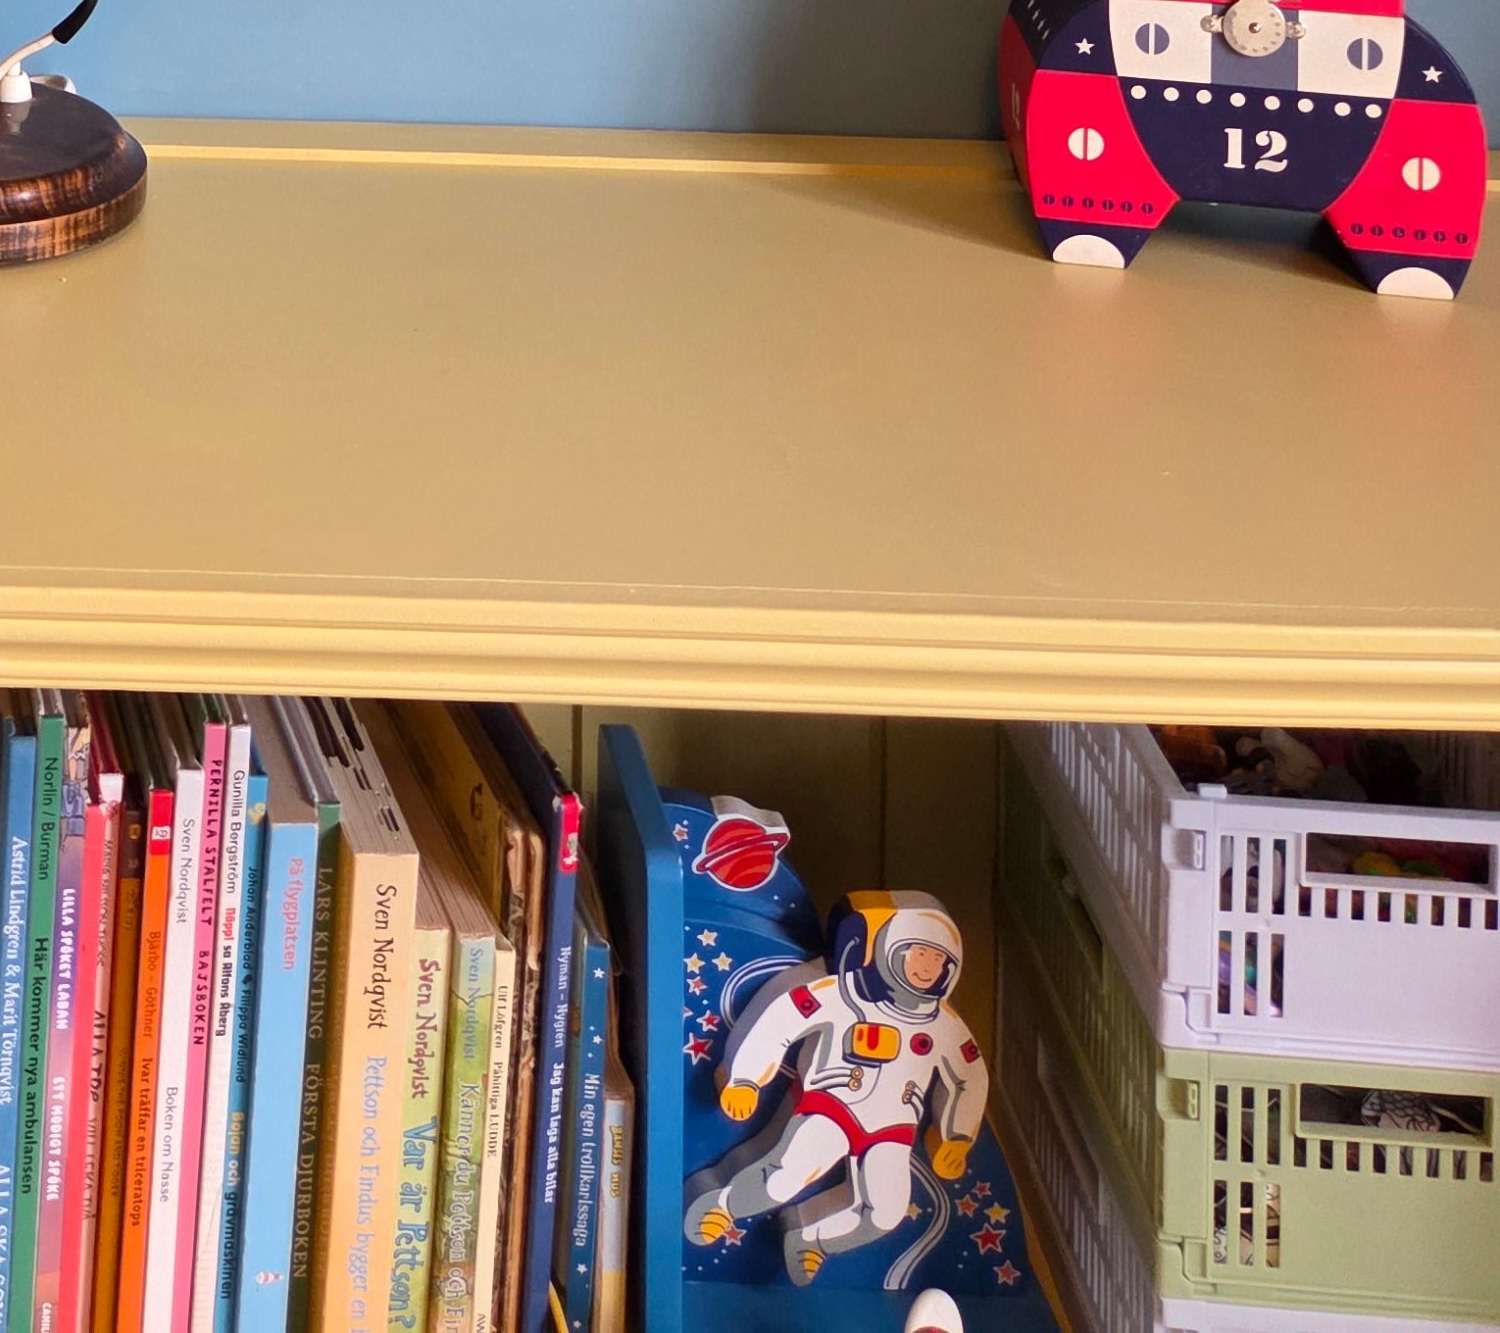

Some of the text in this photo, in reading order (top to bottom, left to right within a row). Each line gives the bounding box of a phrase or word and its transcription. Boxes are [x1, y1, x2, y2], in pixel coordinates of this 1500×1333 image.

[1222, 126, 1289, 173] 12
[231, 769, 245, 818] Gunilla
[9, 836, 28, 885] Astrid
[316, 866, 334, 921] LARS
[2, 888, 26, 960] Lindgren
[60, 888, 76, 926] LILLA
[193, 759, 223, 1045] PERNILLA STALFELT BAJSBOKEN
[282, 857, 306, 971] På flygplatsen
[0, 981, 20, 1027] Marit
[4, 964, 21, 978] &
[21, 757, 59, 1195] Norlin Burman Här kommer nya ambulansen
[55, 984, 72, 1030] LABAN
[160, 818, 196, 1204] Sven Nordqvist Boken Nasse
[220, 962, 233, 999] Alfons
[308, 931, 333, 1040] KLINTING
[215, 1001, 233, 1037] Åberg
[302, 1063, 325, 1145] FÖRSTA
[348, 884, 397, 1319] Sven Nordqvist Pettson och Findus bygger en
[448, 948, 484, 1263] Sven Nordqvist Känner du Pettson
[544, 946, 572, 1203] Nyman Nygren Jag kan laga alla bilar
[130, 1058, 154, 1227] Ivar träffar triceratops
[227, 1112, 244, 1188] Bojan och
[387, 958, 441, 1330] Sven Nordqvist Var är Pettson?
[571, 1073, 600, 1247] Min egen trollkarlssaga
[292, 1149, 316, 1279] DJURBOKEN
